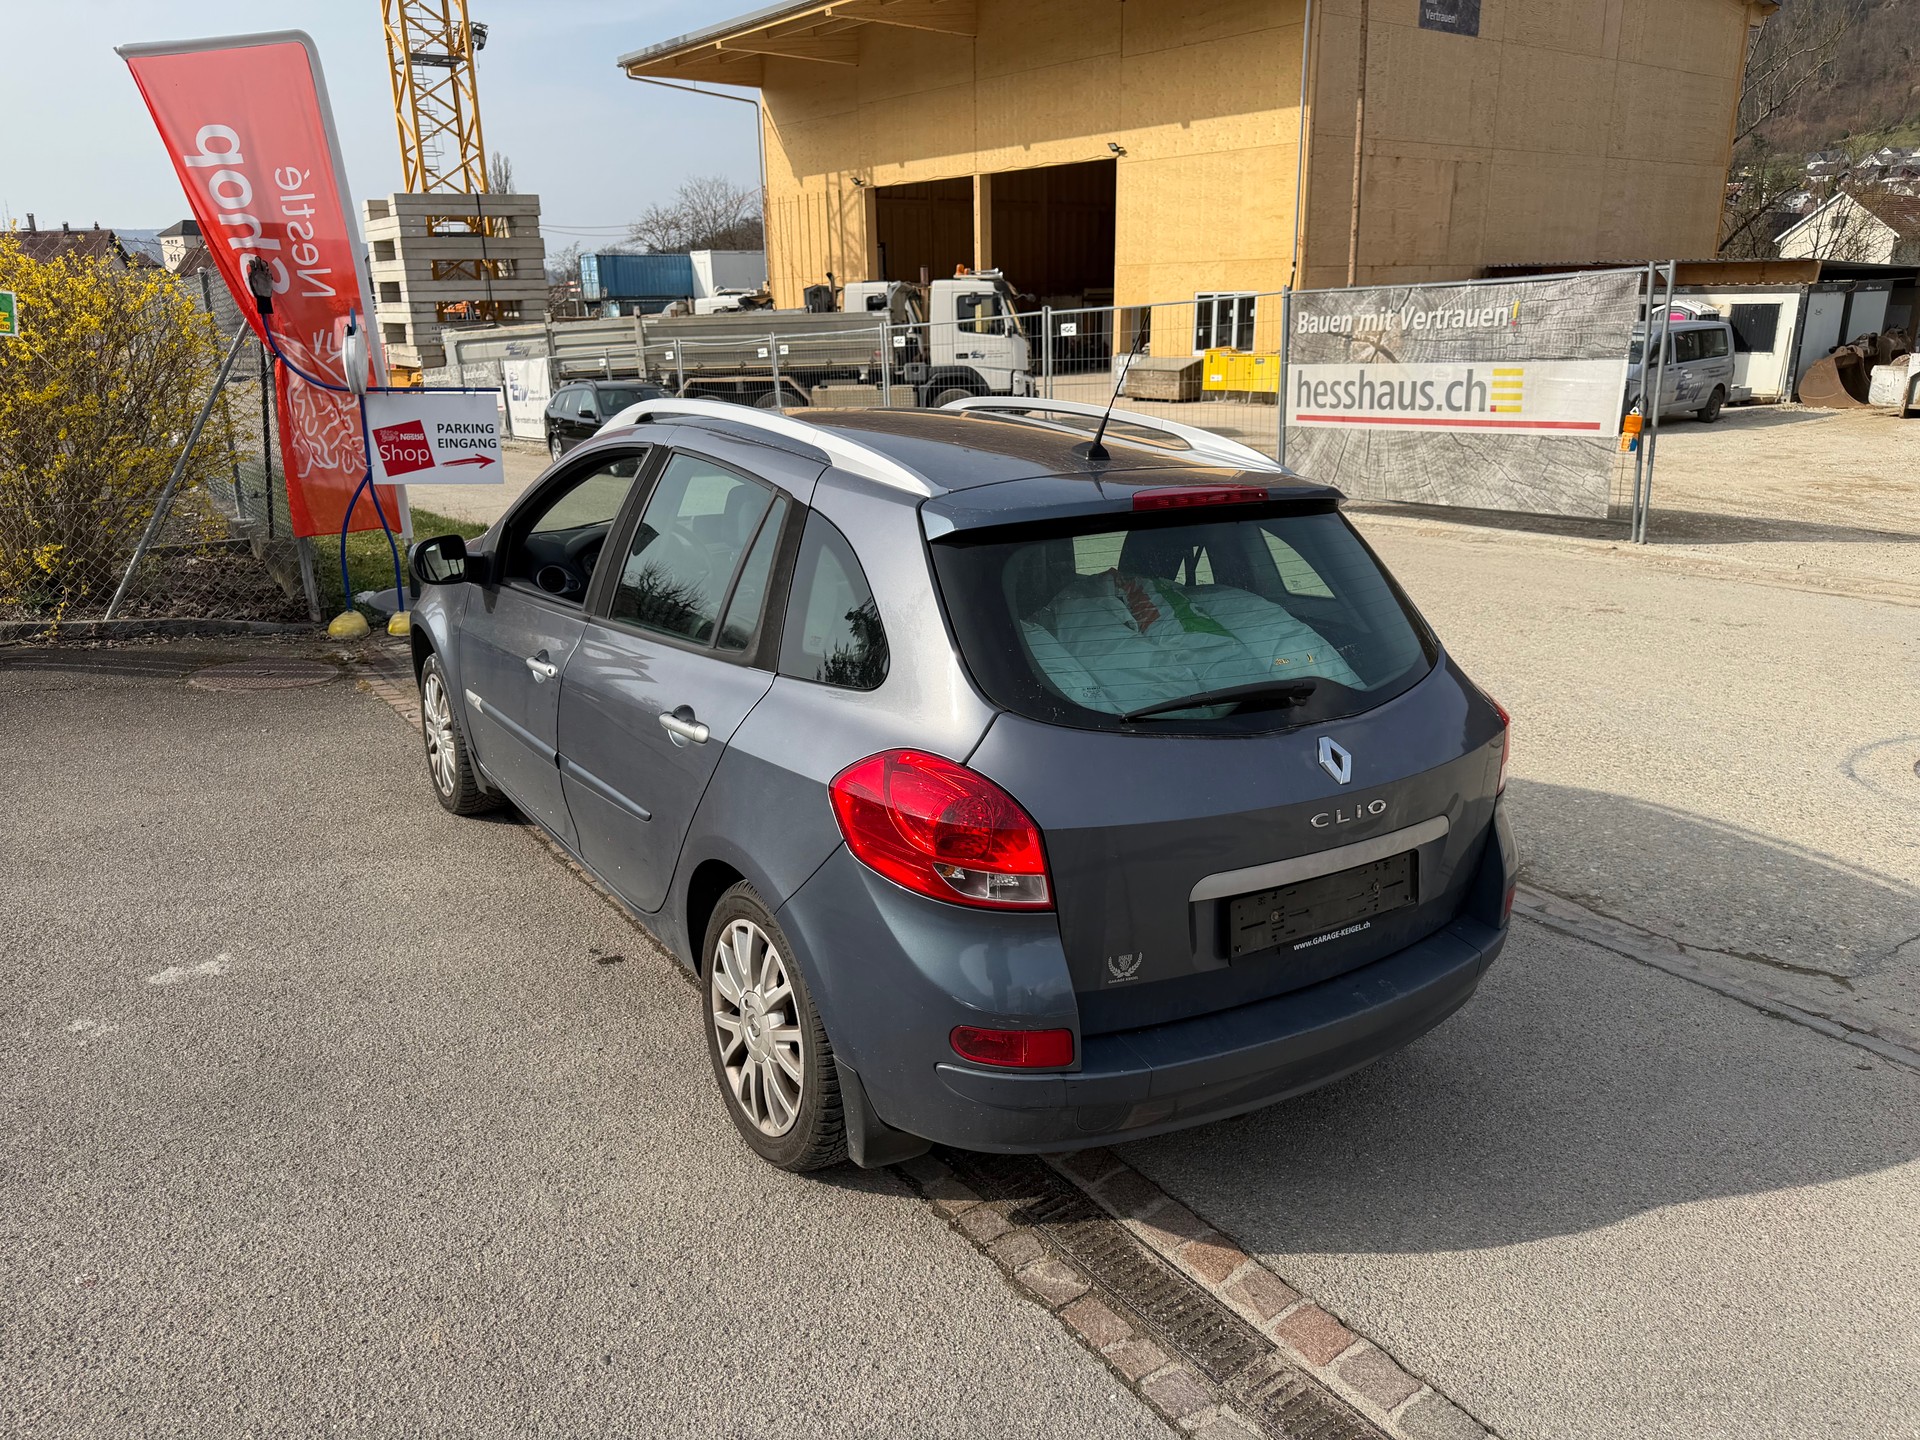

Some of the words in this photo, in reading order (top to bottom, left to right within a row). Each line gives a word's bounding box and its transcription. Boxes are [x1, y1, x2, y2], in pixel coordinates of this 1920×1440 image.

[1297, 311, 1353, 334] Bauen
[1358, 306, 1394, 332] mit
[1400, 300, 1520, 332] Vertrauen!
[1296, 368, 1487, 413] hesshaus.ch
[437, 423, 494, 434] PARKING
[380, 444, 430, 466] Shop
[438, 438, 497, 449] EINGANG
[1310, 799, 1387, 828] CLIO
[1293, 920, 1372, 951] www.GARAGE-KEIGEL.ch
